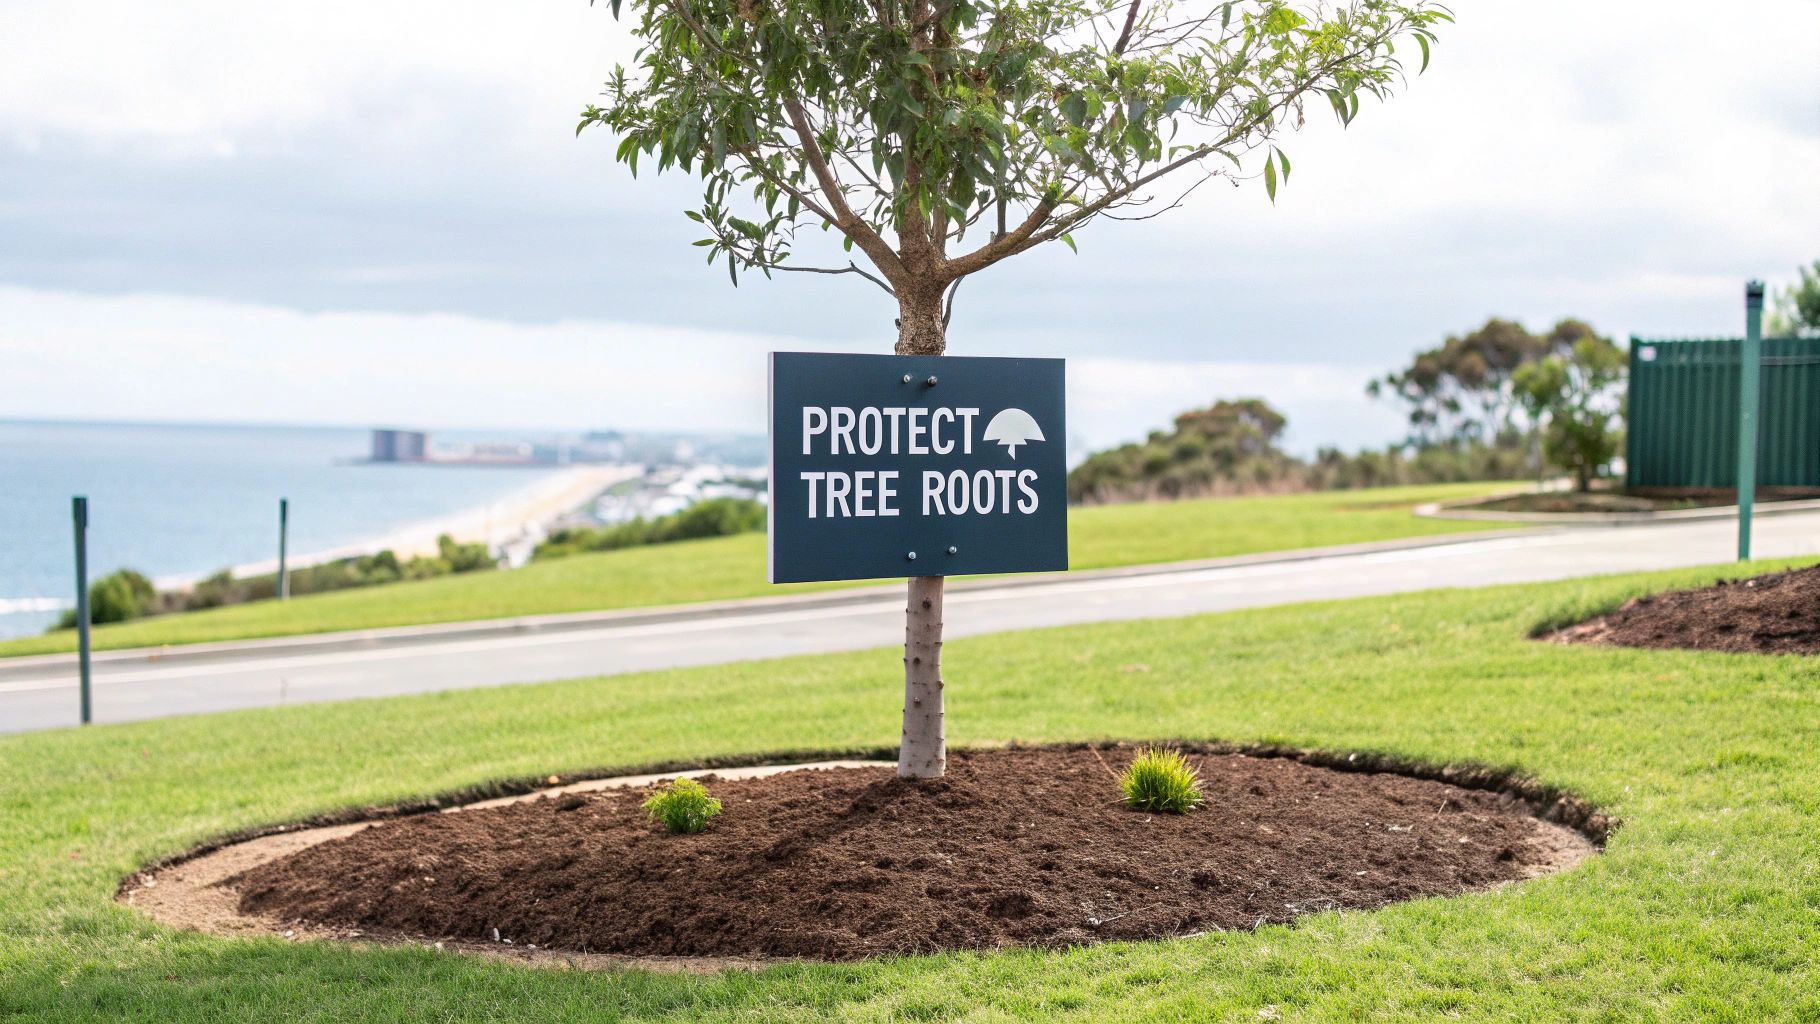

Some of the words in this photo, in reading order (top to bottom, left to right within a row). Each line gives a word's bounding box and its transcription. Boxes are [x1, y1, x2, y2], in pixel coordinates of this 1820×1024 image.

[802, 406, 980, 455] PROTECT
[800, 471, 900, 518] TREE
[922, 469, 1039, 515] ROOTS
